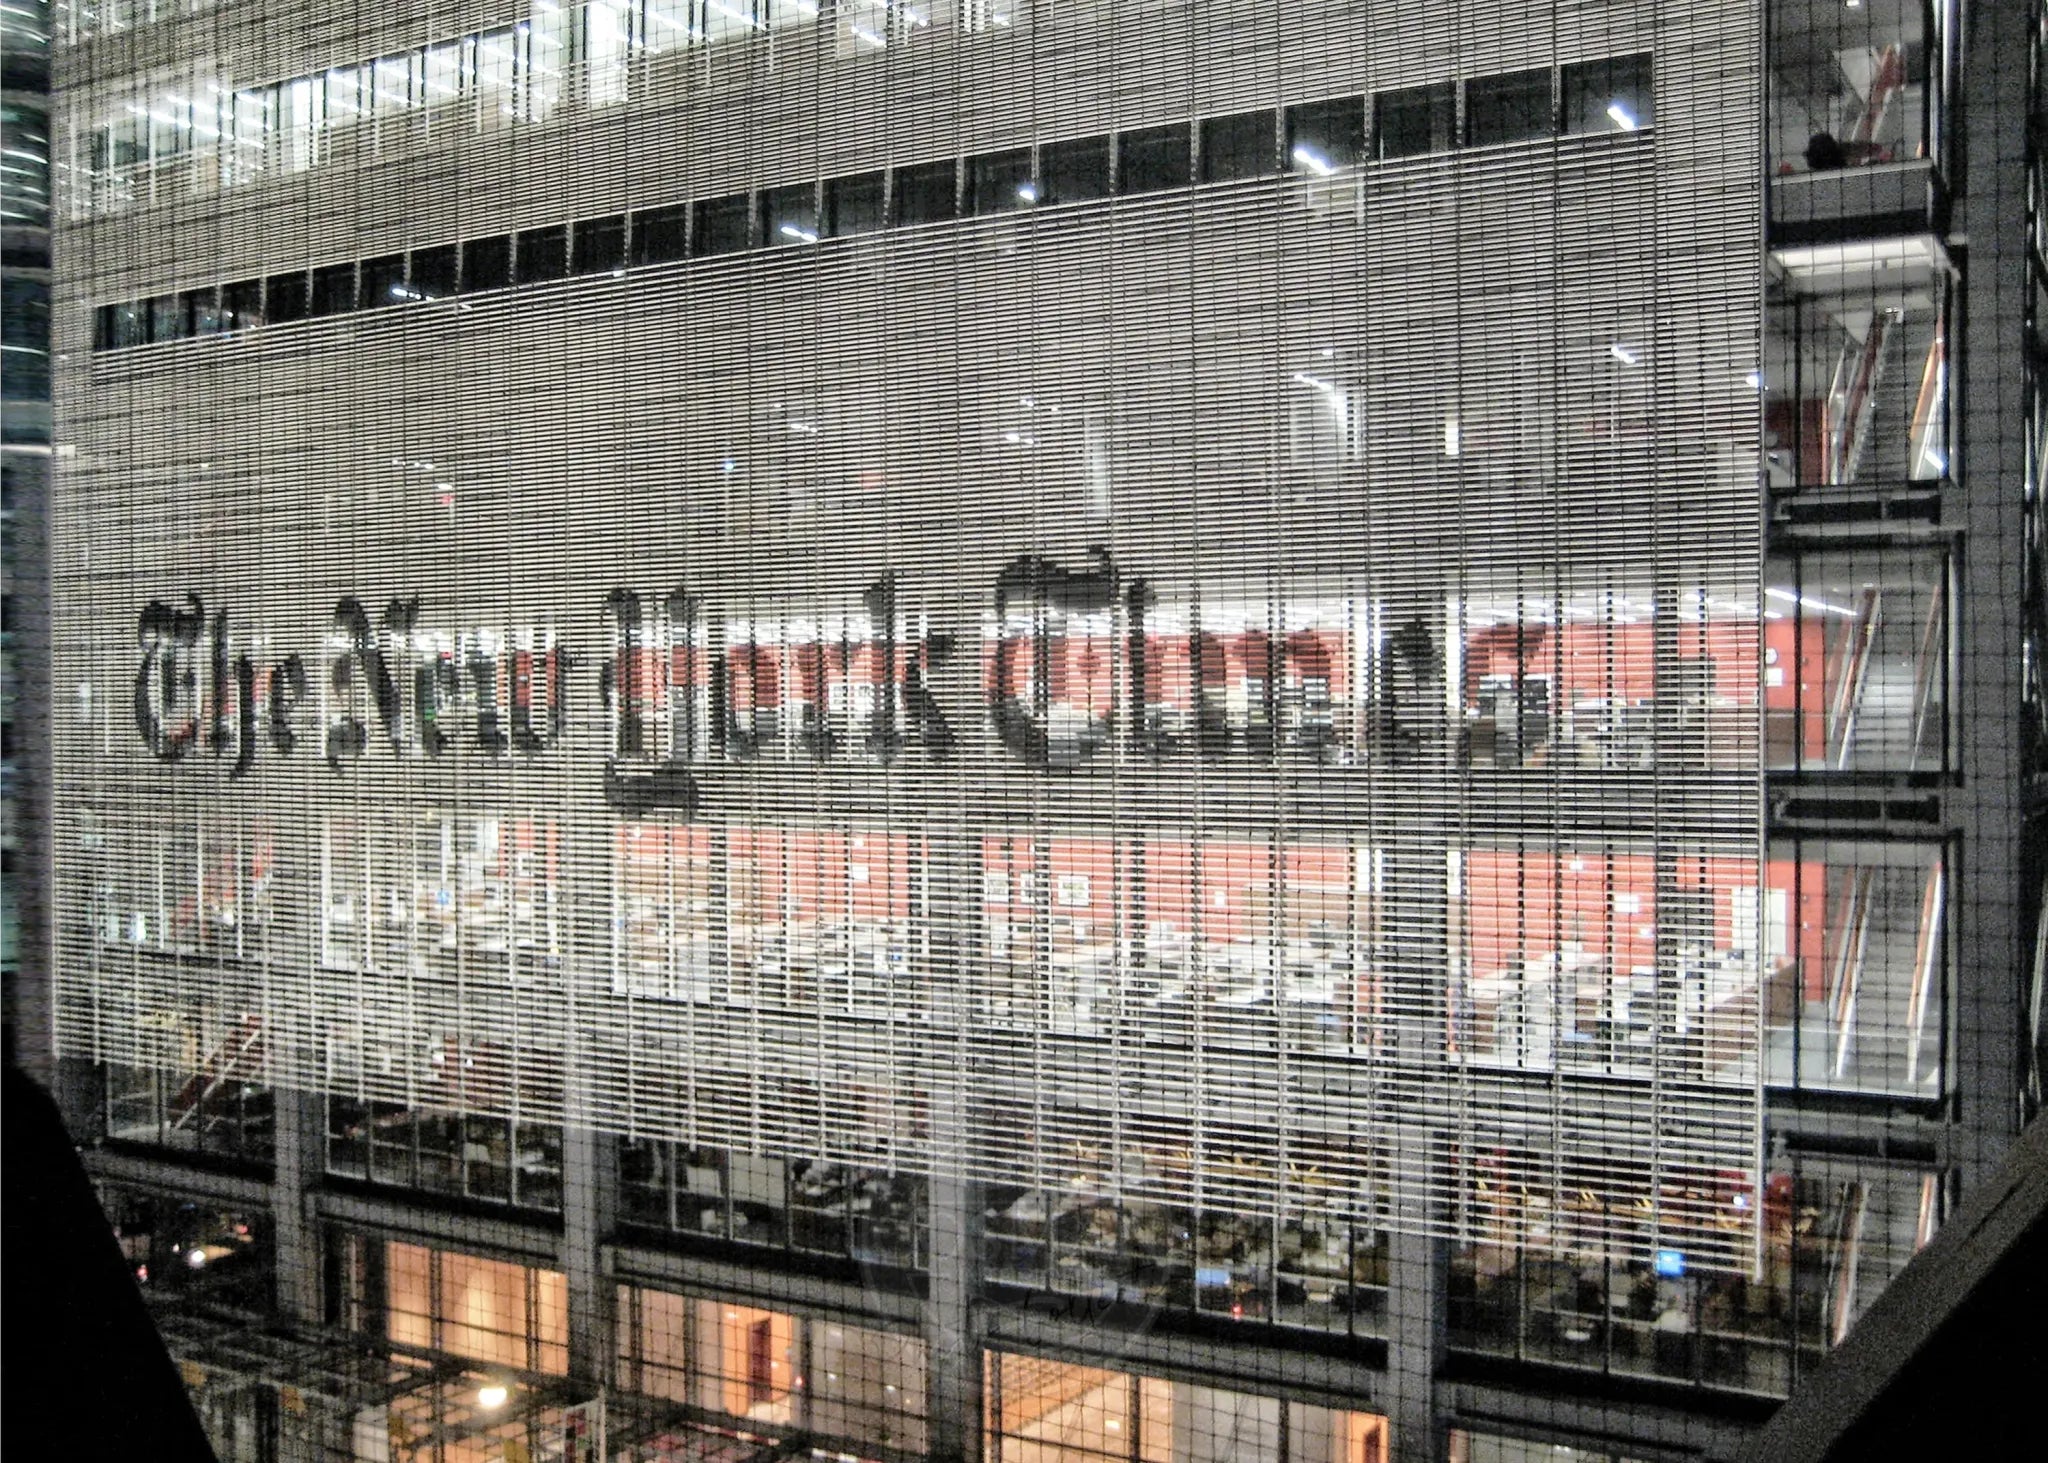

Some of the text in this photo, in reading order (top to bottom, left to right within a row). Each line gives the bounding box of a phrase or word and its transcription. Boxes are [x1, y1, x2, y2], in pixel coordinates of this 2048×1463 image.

[134, 545, 1549, 819] The New York Times
